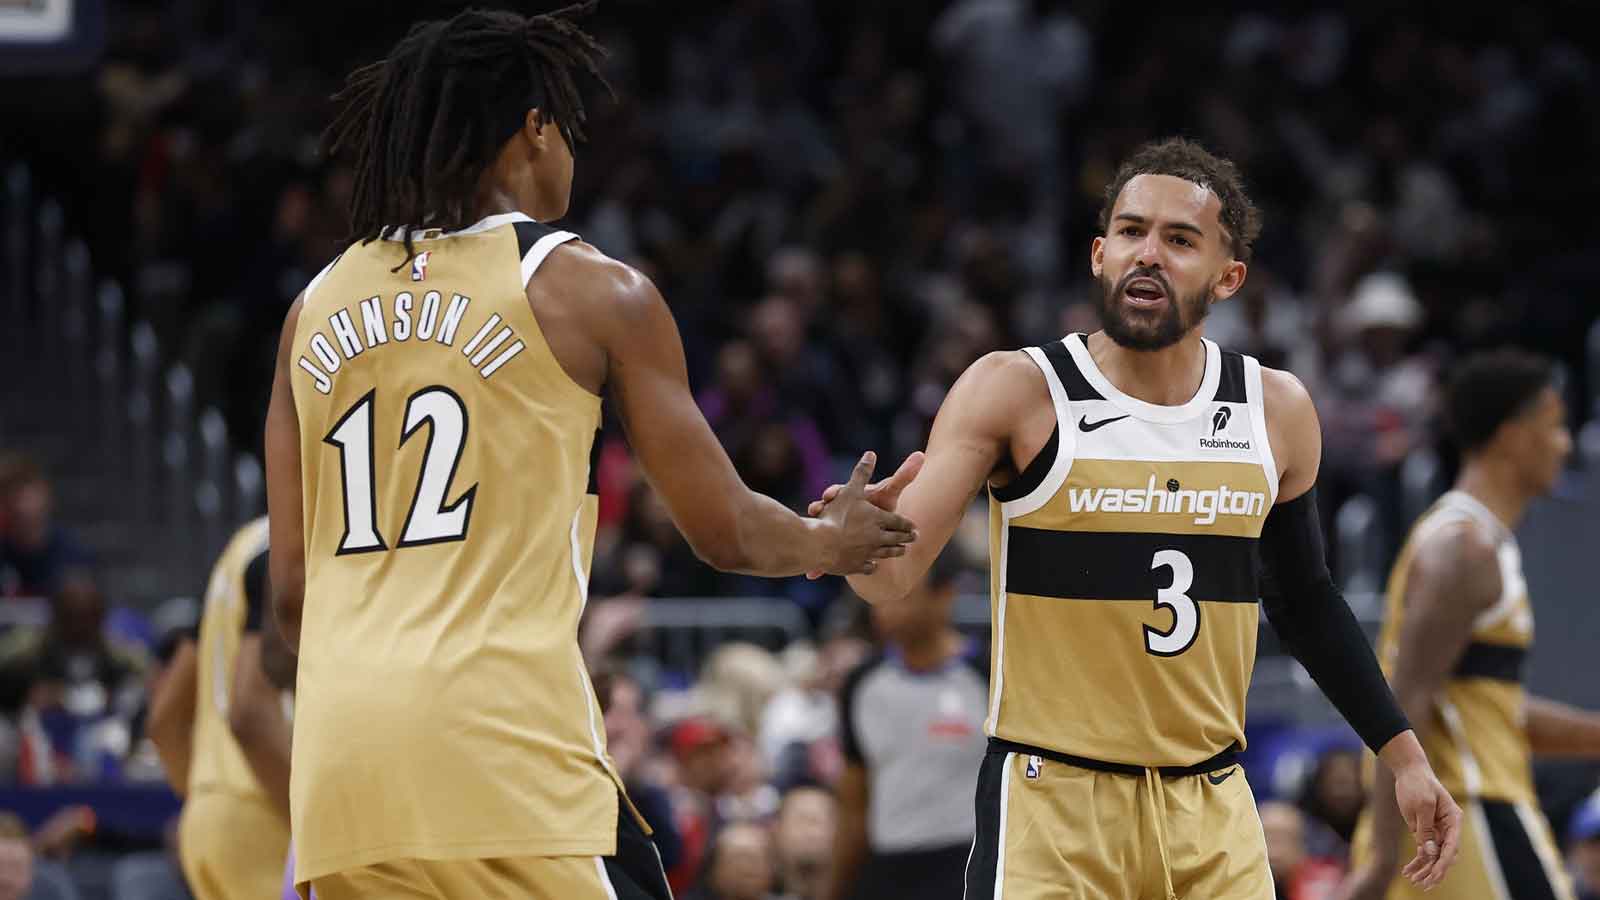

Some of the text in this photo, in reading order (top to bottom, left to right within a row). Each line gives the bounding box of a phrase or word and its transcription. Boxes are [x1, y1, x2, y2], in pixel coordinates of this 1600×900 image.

[298, 290, 526, 395] JOHNSON III
[322, 385, 479, 556] 12
[1199, 438, 1251, 450] Robinhood
[1068, 473, 1265, 525] washington
[1142, 547, 1201, 657] 3
